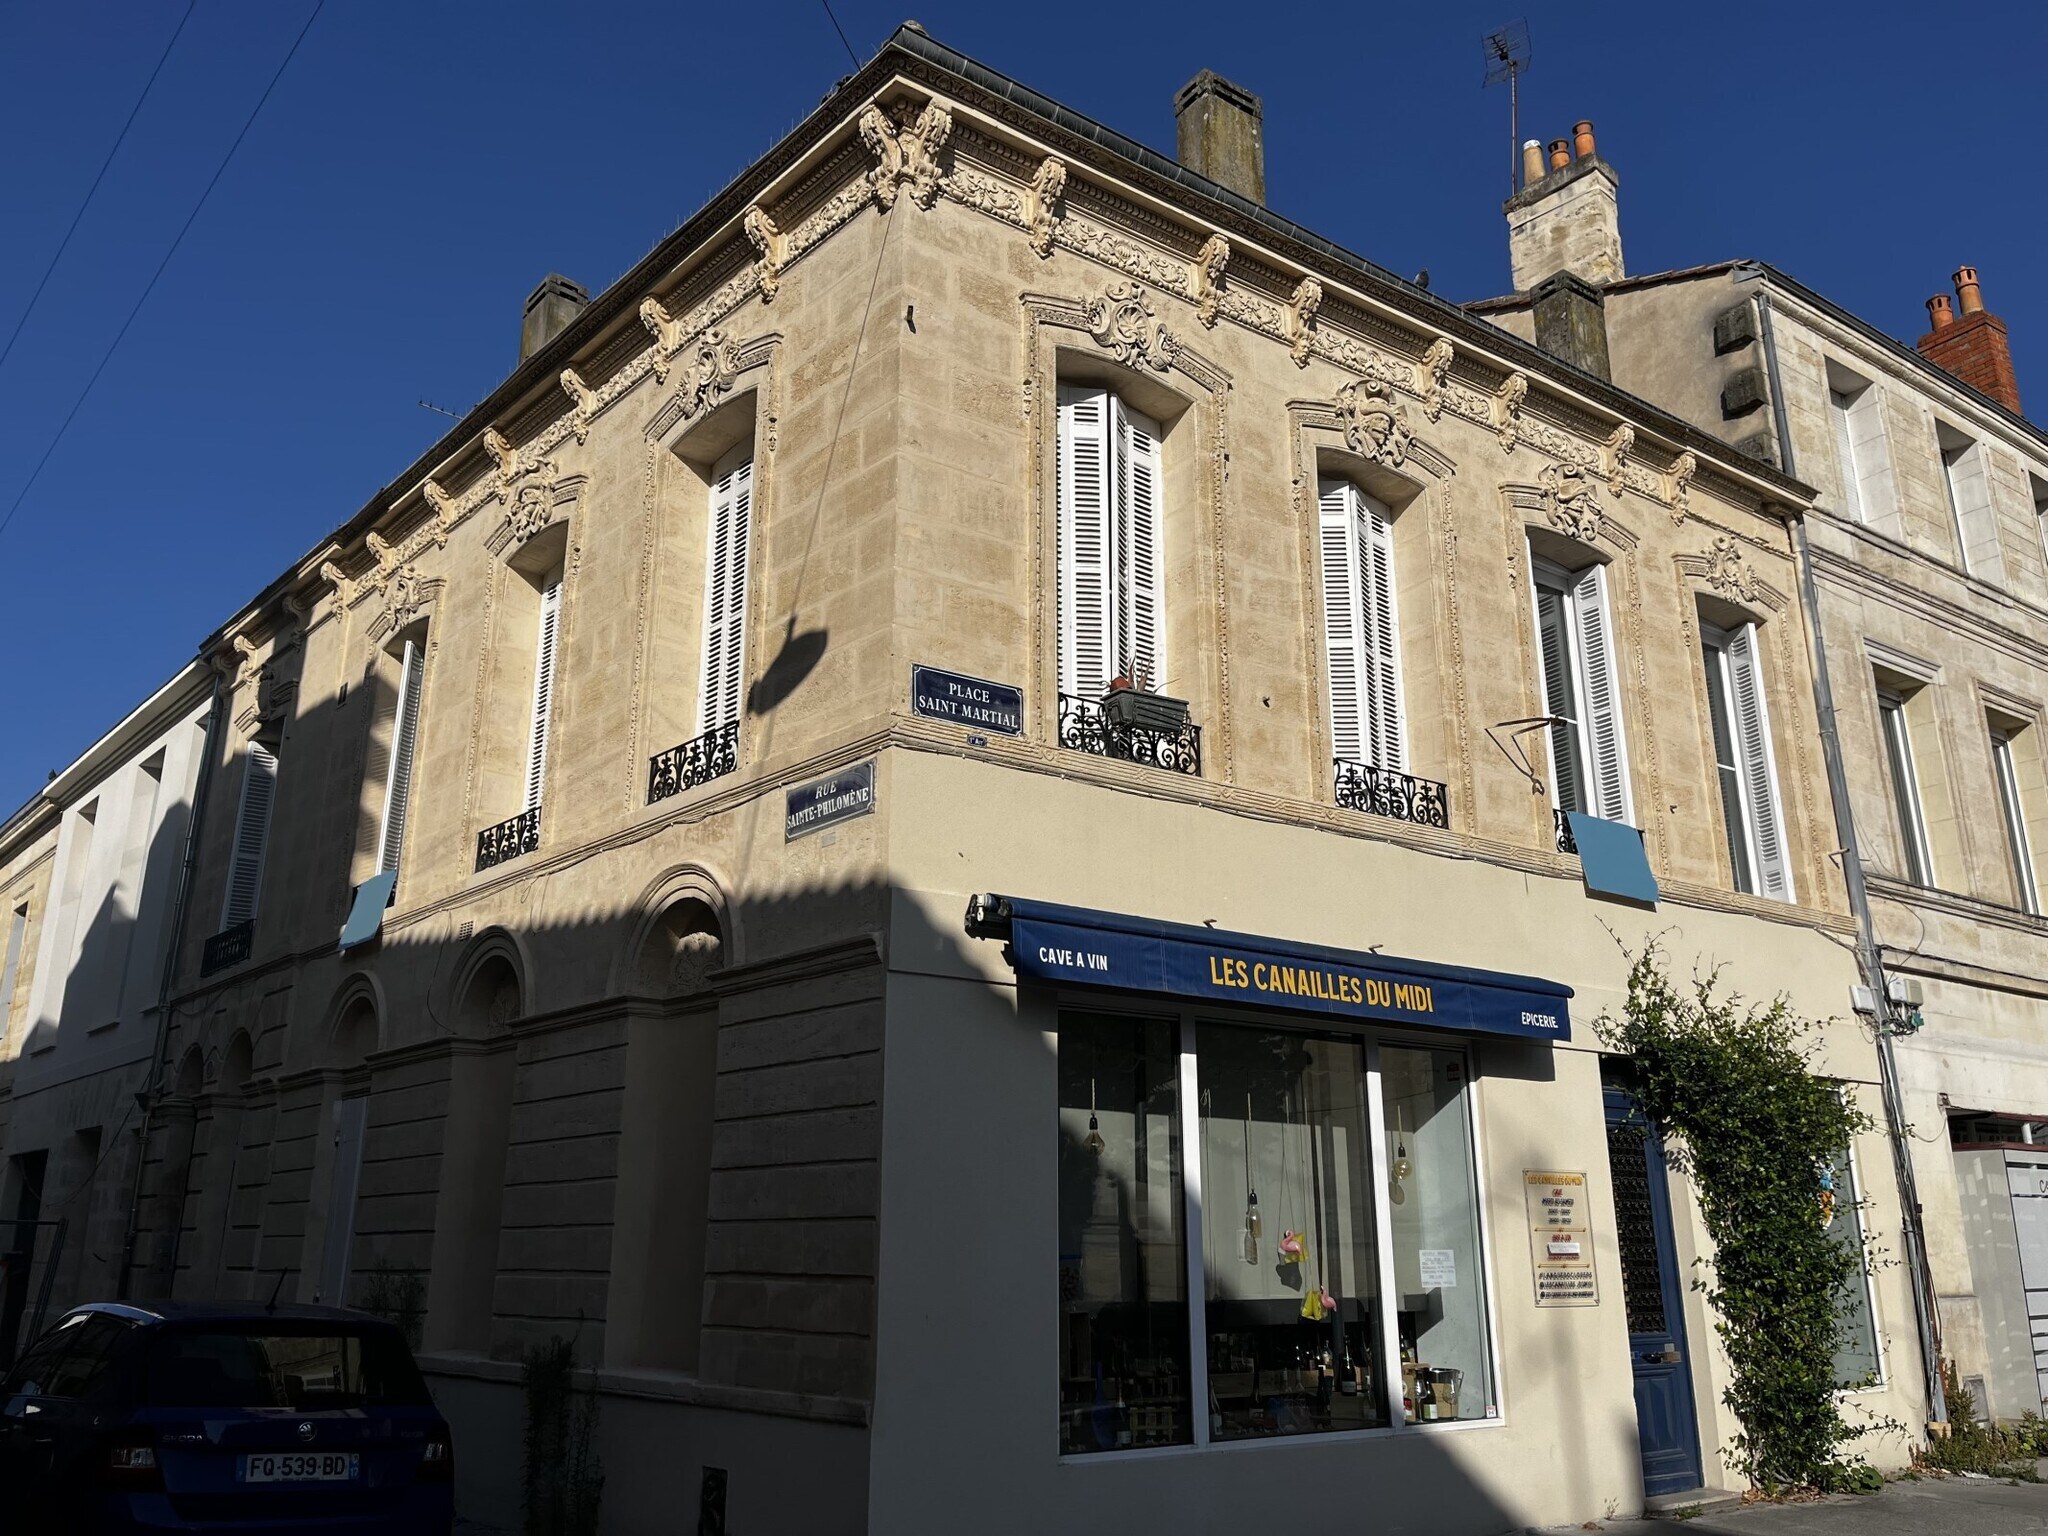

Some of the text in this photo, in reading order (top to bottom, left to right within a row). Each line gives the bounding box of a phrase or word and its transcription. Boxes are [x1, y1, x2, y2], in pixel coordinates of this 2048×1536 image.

[948, 682, 990, 704] PLACE
[918, 695, 1019, 729] SAINT MARTIAL
[815, 780, 837, 799] RUE
[787, 786, 869, 830] SAINTE-PHILOMÈNE
[1039, 946, 1108, 971] CAVE A VIN
[1210, 956, 1434, 1013] LES CANAILLES DU MIDI
[1521, 1011, 1559, 1029] EPICERIE
[250, 1456, 346, 1477] FQ-539-BD
